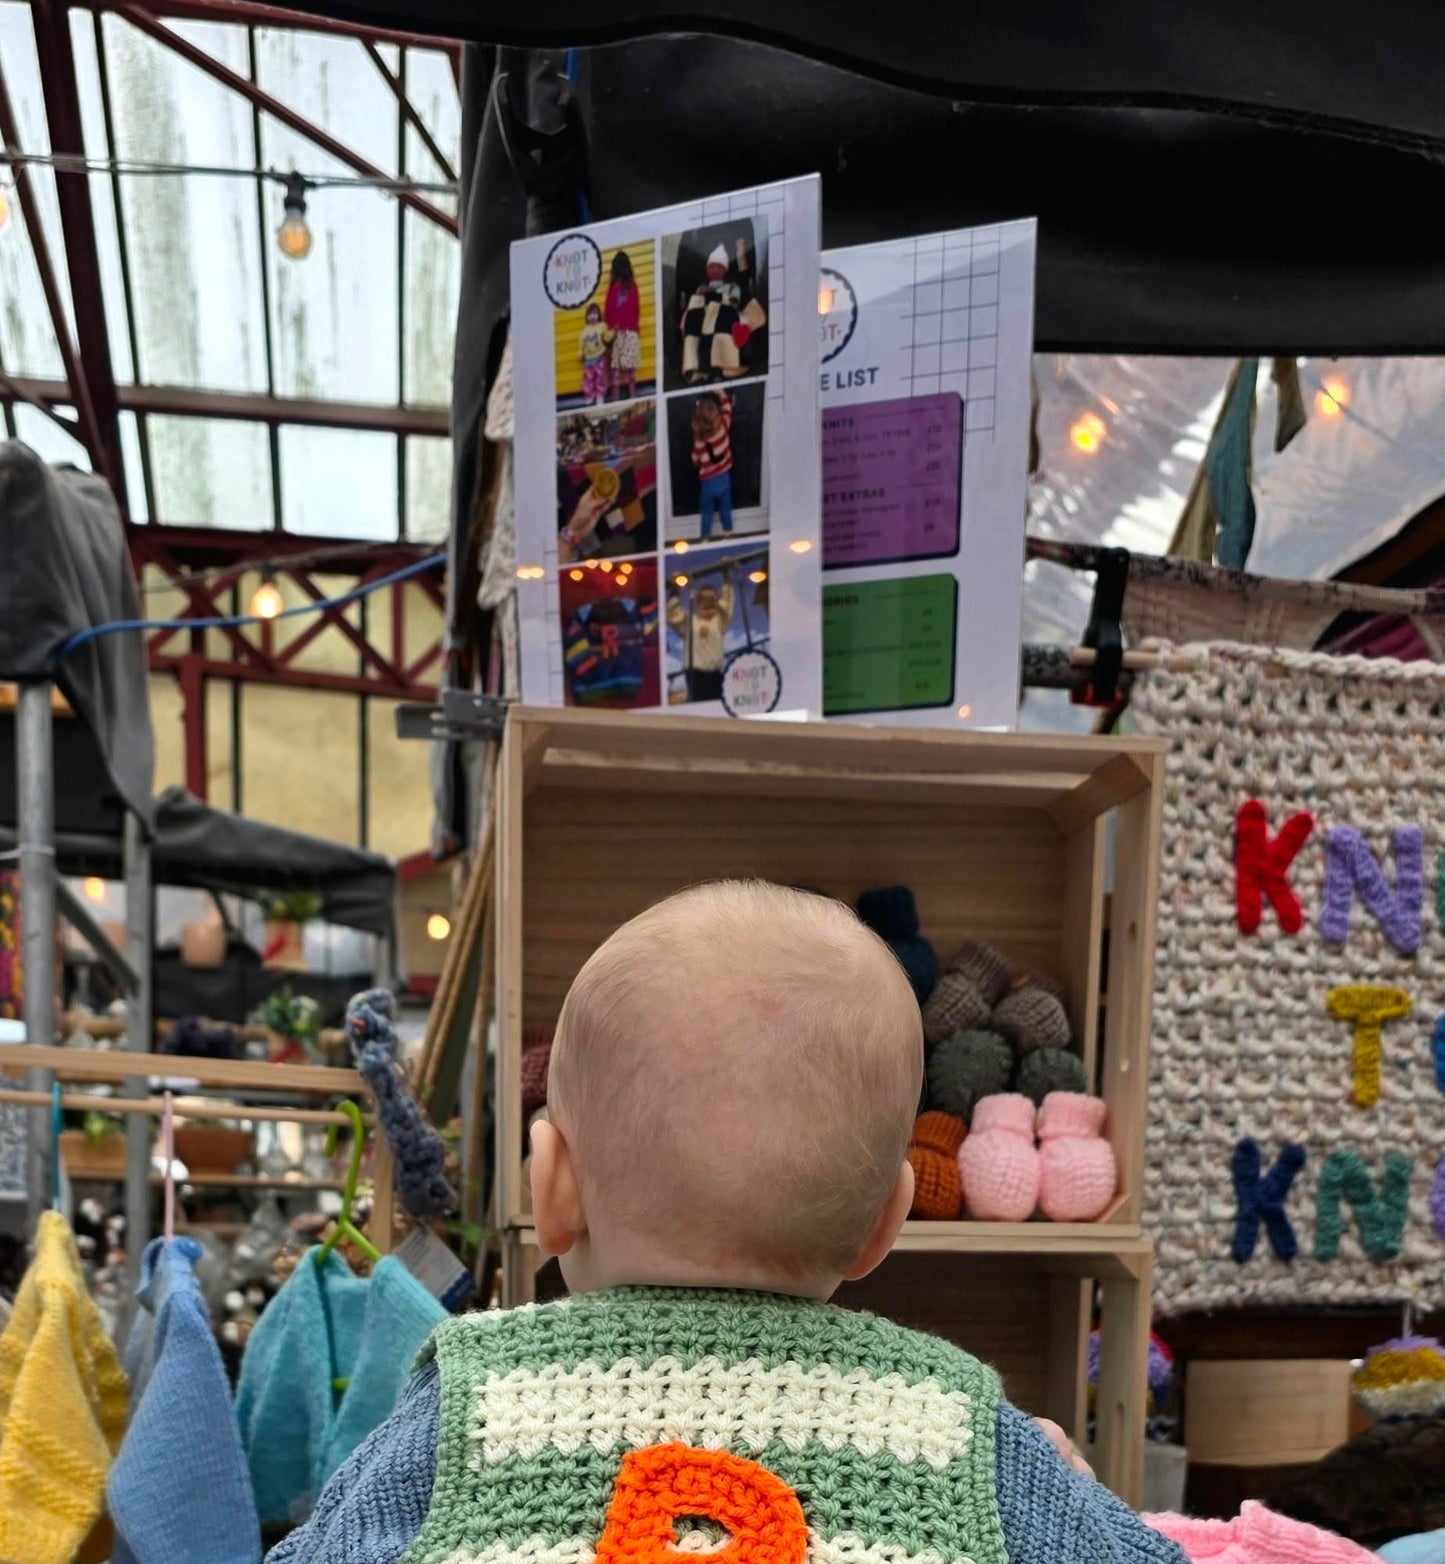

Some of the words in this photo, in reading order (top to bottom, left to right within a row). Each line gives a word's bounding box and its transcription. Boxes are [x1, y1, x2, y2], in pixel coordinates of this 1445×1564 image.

[554, 249, 588, 268] KNOT
[556, 275, 588, 294] KNOT
[836, 366, 880, 389] LIST
[840, 488, 886, 502] EXTRAS
[733, 665, 767, 681] KNOT
[734, 690, 768, 707] KNOT
[1235, 798, 1445, 954] KN
[1325, 985, 1445, 1109] T
[1231, 1136, 1445, 1264] KN
